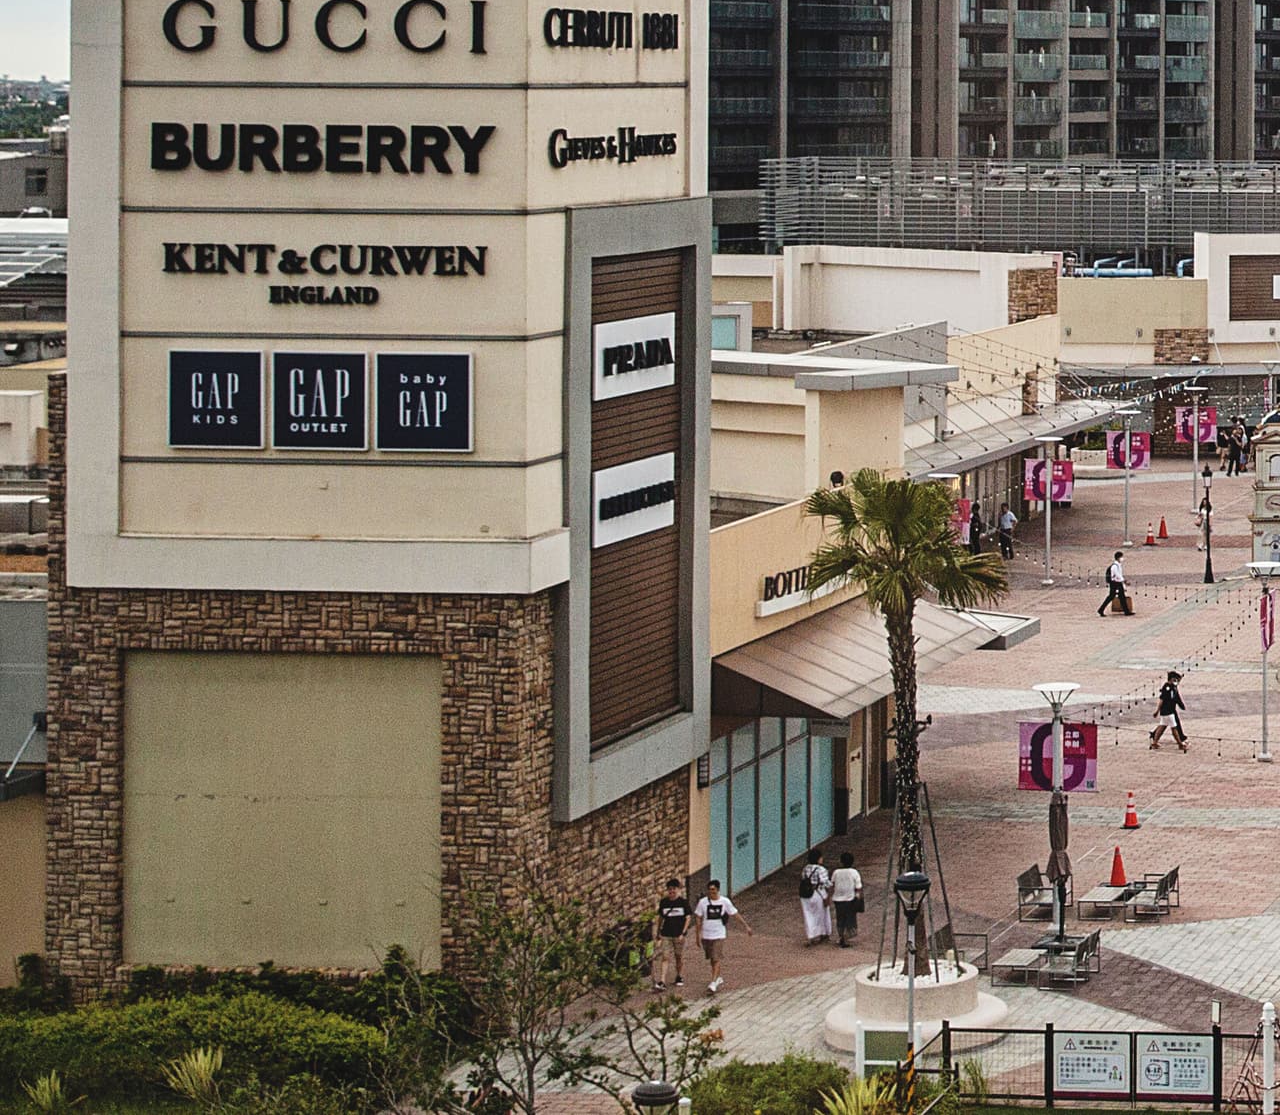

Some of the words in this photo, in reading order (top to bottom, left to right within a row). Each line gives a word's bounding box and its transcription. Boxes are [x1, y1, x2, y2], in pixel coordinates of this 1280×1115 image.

[544, 8, 632, 49] CERRUTI
[642, 13, 678, 49] 1881
[151, 122, 496, 174] BURBERRY
[269, 285, 379, 304] ENGLAND
[603, 338, 674, 377] PRADA
[191, 372, 239, 409] GAP
[290, 368, 350, 417] GAP
[400, 373, 447, 385] baby
[193, 414, 238, 425] KIDS
[400, 391, 447, 427] GAP
[290, 422, 347, 433] OUTLET
